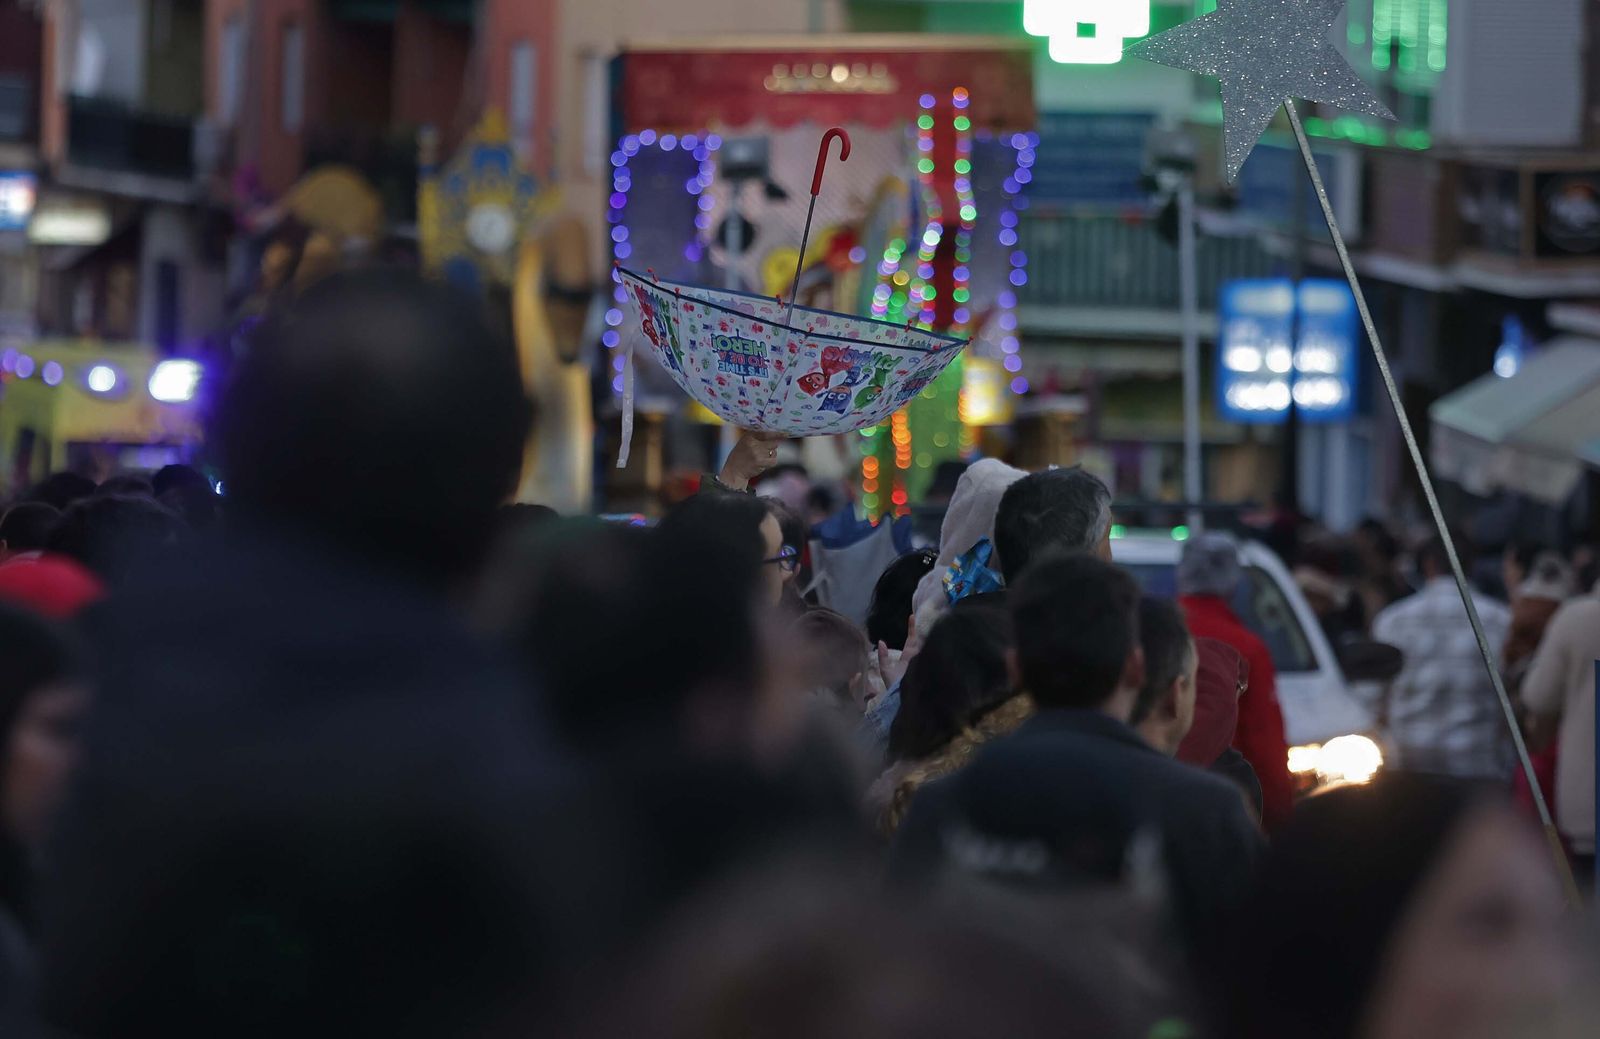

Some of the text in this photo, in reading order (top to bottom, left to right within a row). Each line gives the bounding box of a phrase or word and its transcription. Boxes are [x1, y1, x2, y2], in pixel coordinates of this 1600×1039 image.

[711, 334, 768, 358] HERO!
[718, 350, 768, 368] TO BE A
[718, 360, 769, 378] IT'S TIME
